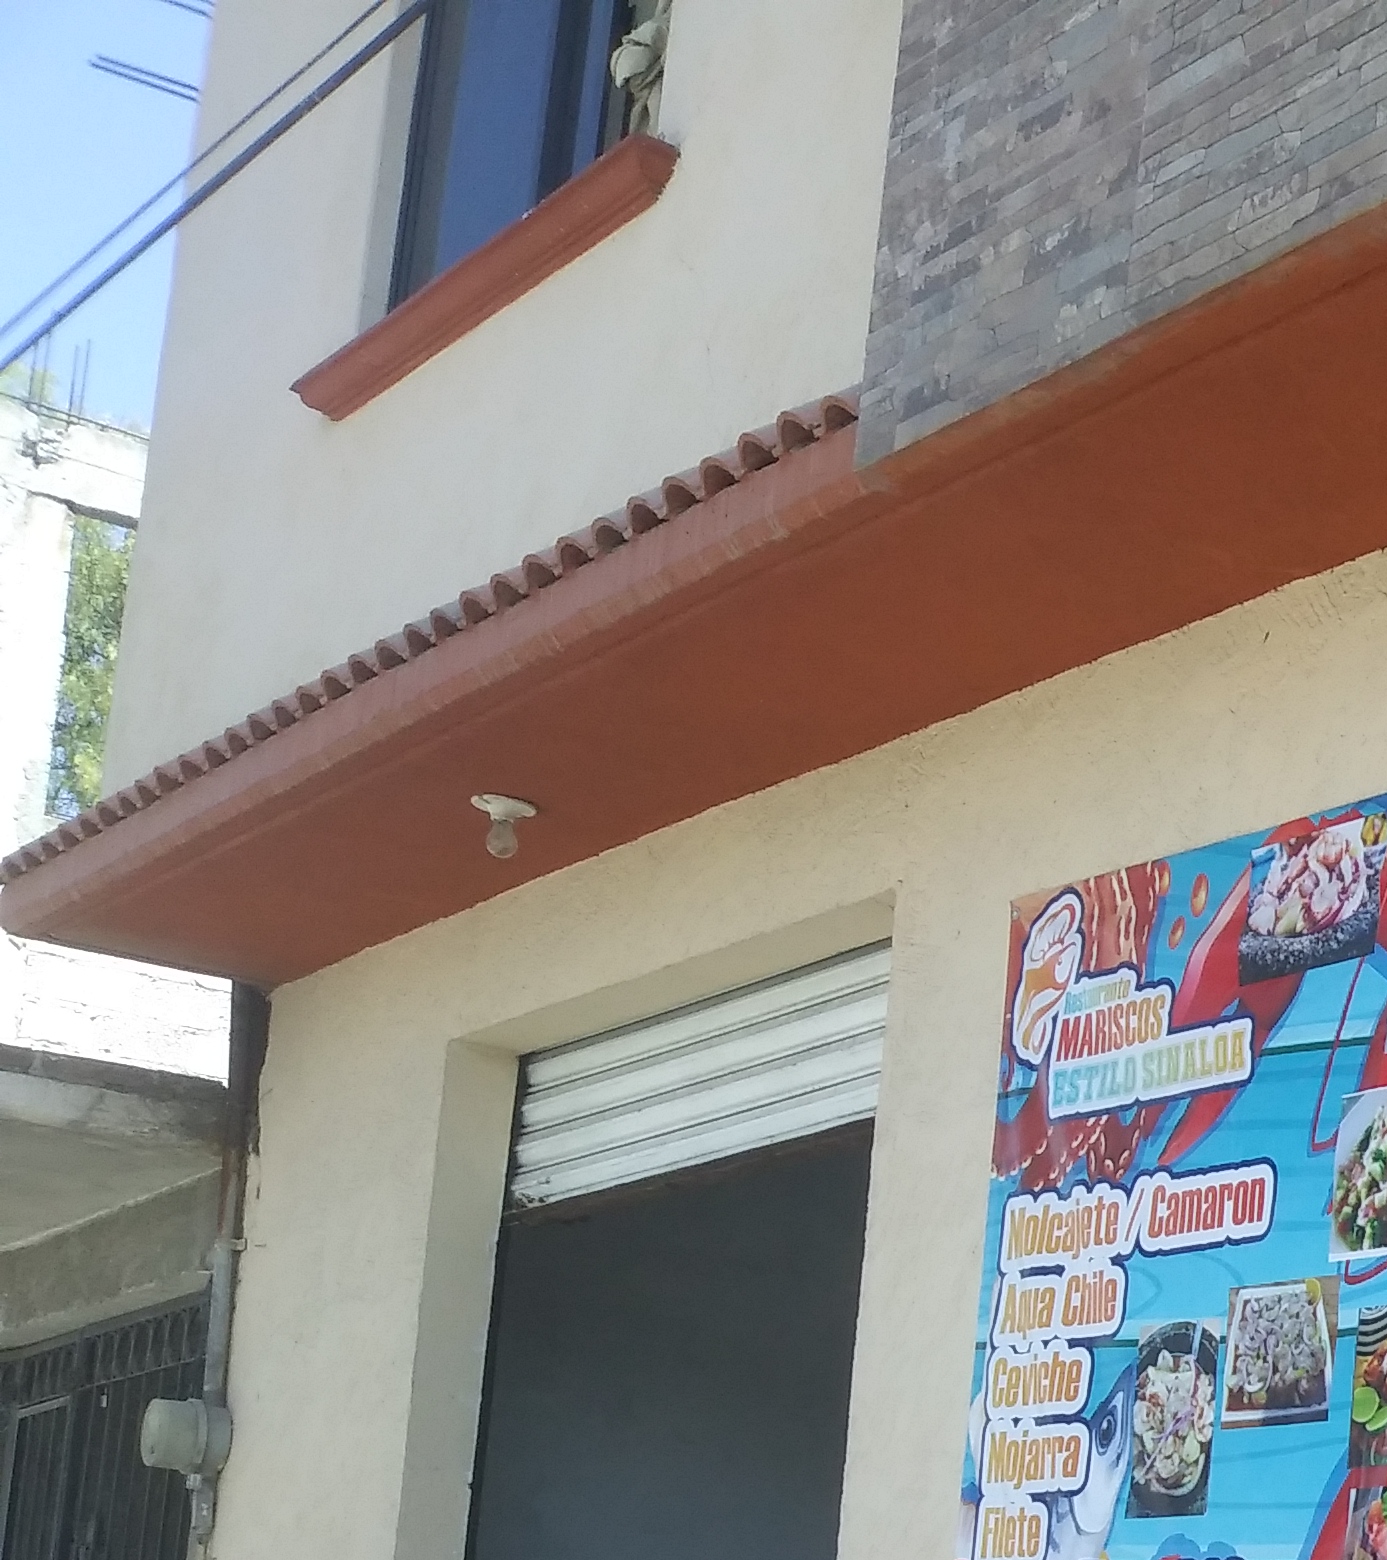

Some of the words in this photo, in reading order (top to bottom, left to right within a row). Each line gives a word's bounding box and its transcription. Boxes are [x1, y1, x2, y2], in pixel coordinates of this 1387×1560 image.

[1055, 994, 1166, 1062] MARISCOS
[1051, 1056, 1136, 1107] ESTILO
[1141, 1027, 1246, 1091] SINALOA
[1006, 1195, 1119, 1260] Molcajete
[1147, 1176, 1266, 1239] Camaron
[1061, 1270, 1118, 1327] Chile
[992, 1351, 1083, 1408] Ceviche
[986, 1429, 1081, 1490] Mojarra
[979, 1506, 1041, 1560] Filete
